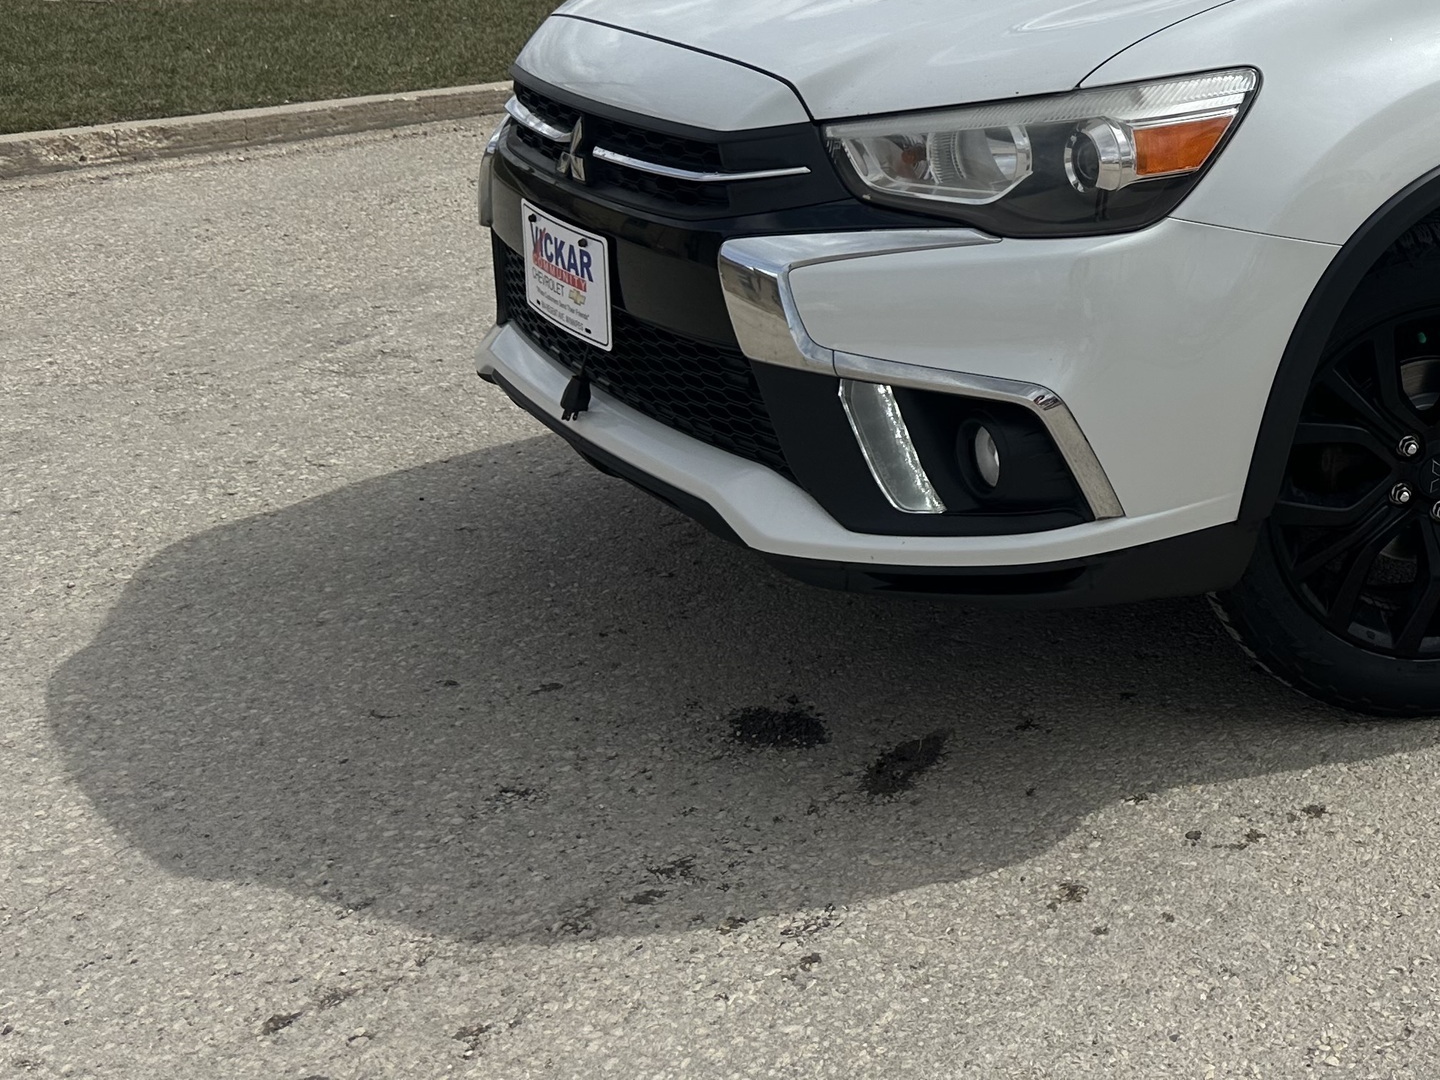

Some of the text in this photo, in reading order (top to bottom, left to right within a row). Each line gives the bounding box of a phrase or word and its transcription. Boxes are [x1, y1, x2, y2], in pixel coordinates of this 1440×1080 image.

[530, 222, 594, 283] VICKAR
[532, 266, 565, 297] CHEVROLET
[534, 254, 587, 292] COMMUNITY
